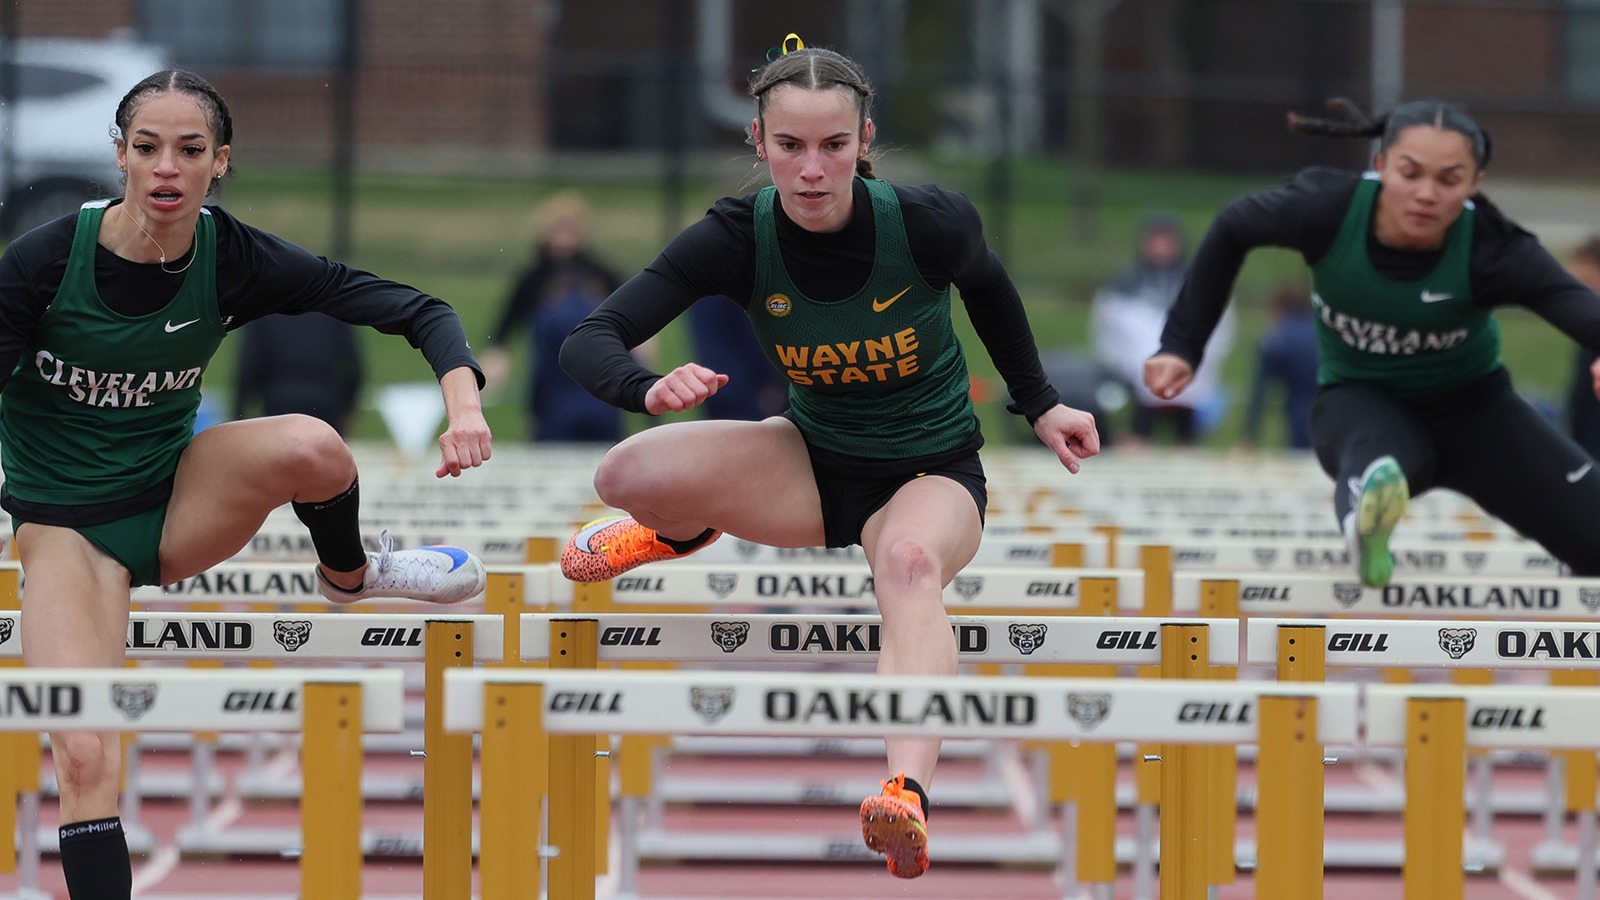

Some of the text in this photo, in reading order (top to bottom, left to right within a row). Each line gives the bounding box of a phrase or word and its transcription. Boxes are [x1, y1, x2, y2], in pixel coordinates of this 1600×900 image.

[775, 327, 920, 369] WAYNE
[35, 350, 201, 393] CLEVELAND
[787, 354, 920, 386] STATE
[161, 572, 322, 596] AKLAN
[616, 574, 1076, 598] GILL OAKLA GILL
[1242, 585, 1561, 610] GILL OAKLAND
[127, 621, 422, 649] LAND GILL
[600, 623, 1157, 652] GILL OAKLD GILL
[1328, 630, 1600, 659] GILL OAK
[223, 690, 297, 712] GILL
[551, 690, 1251, 726] GILL OAKLAND GILL
[1471, 707, 1546, 729] GILL
